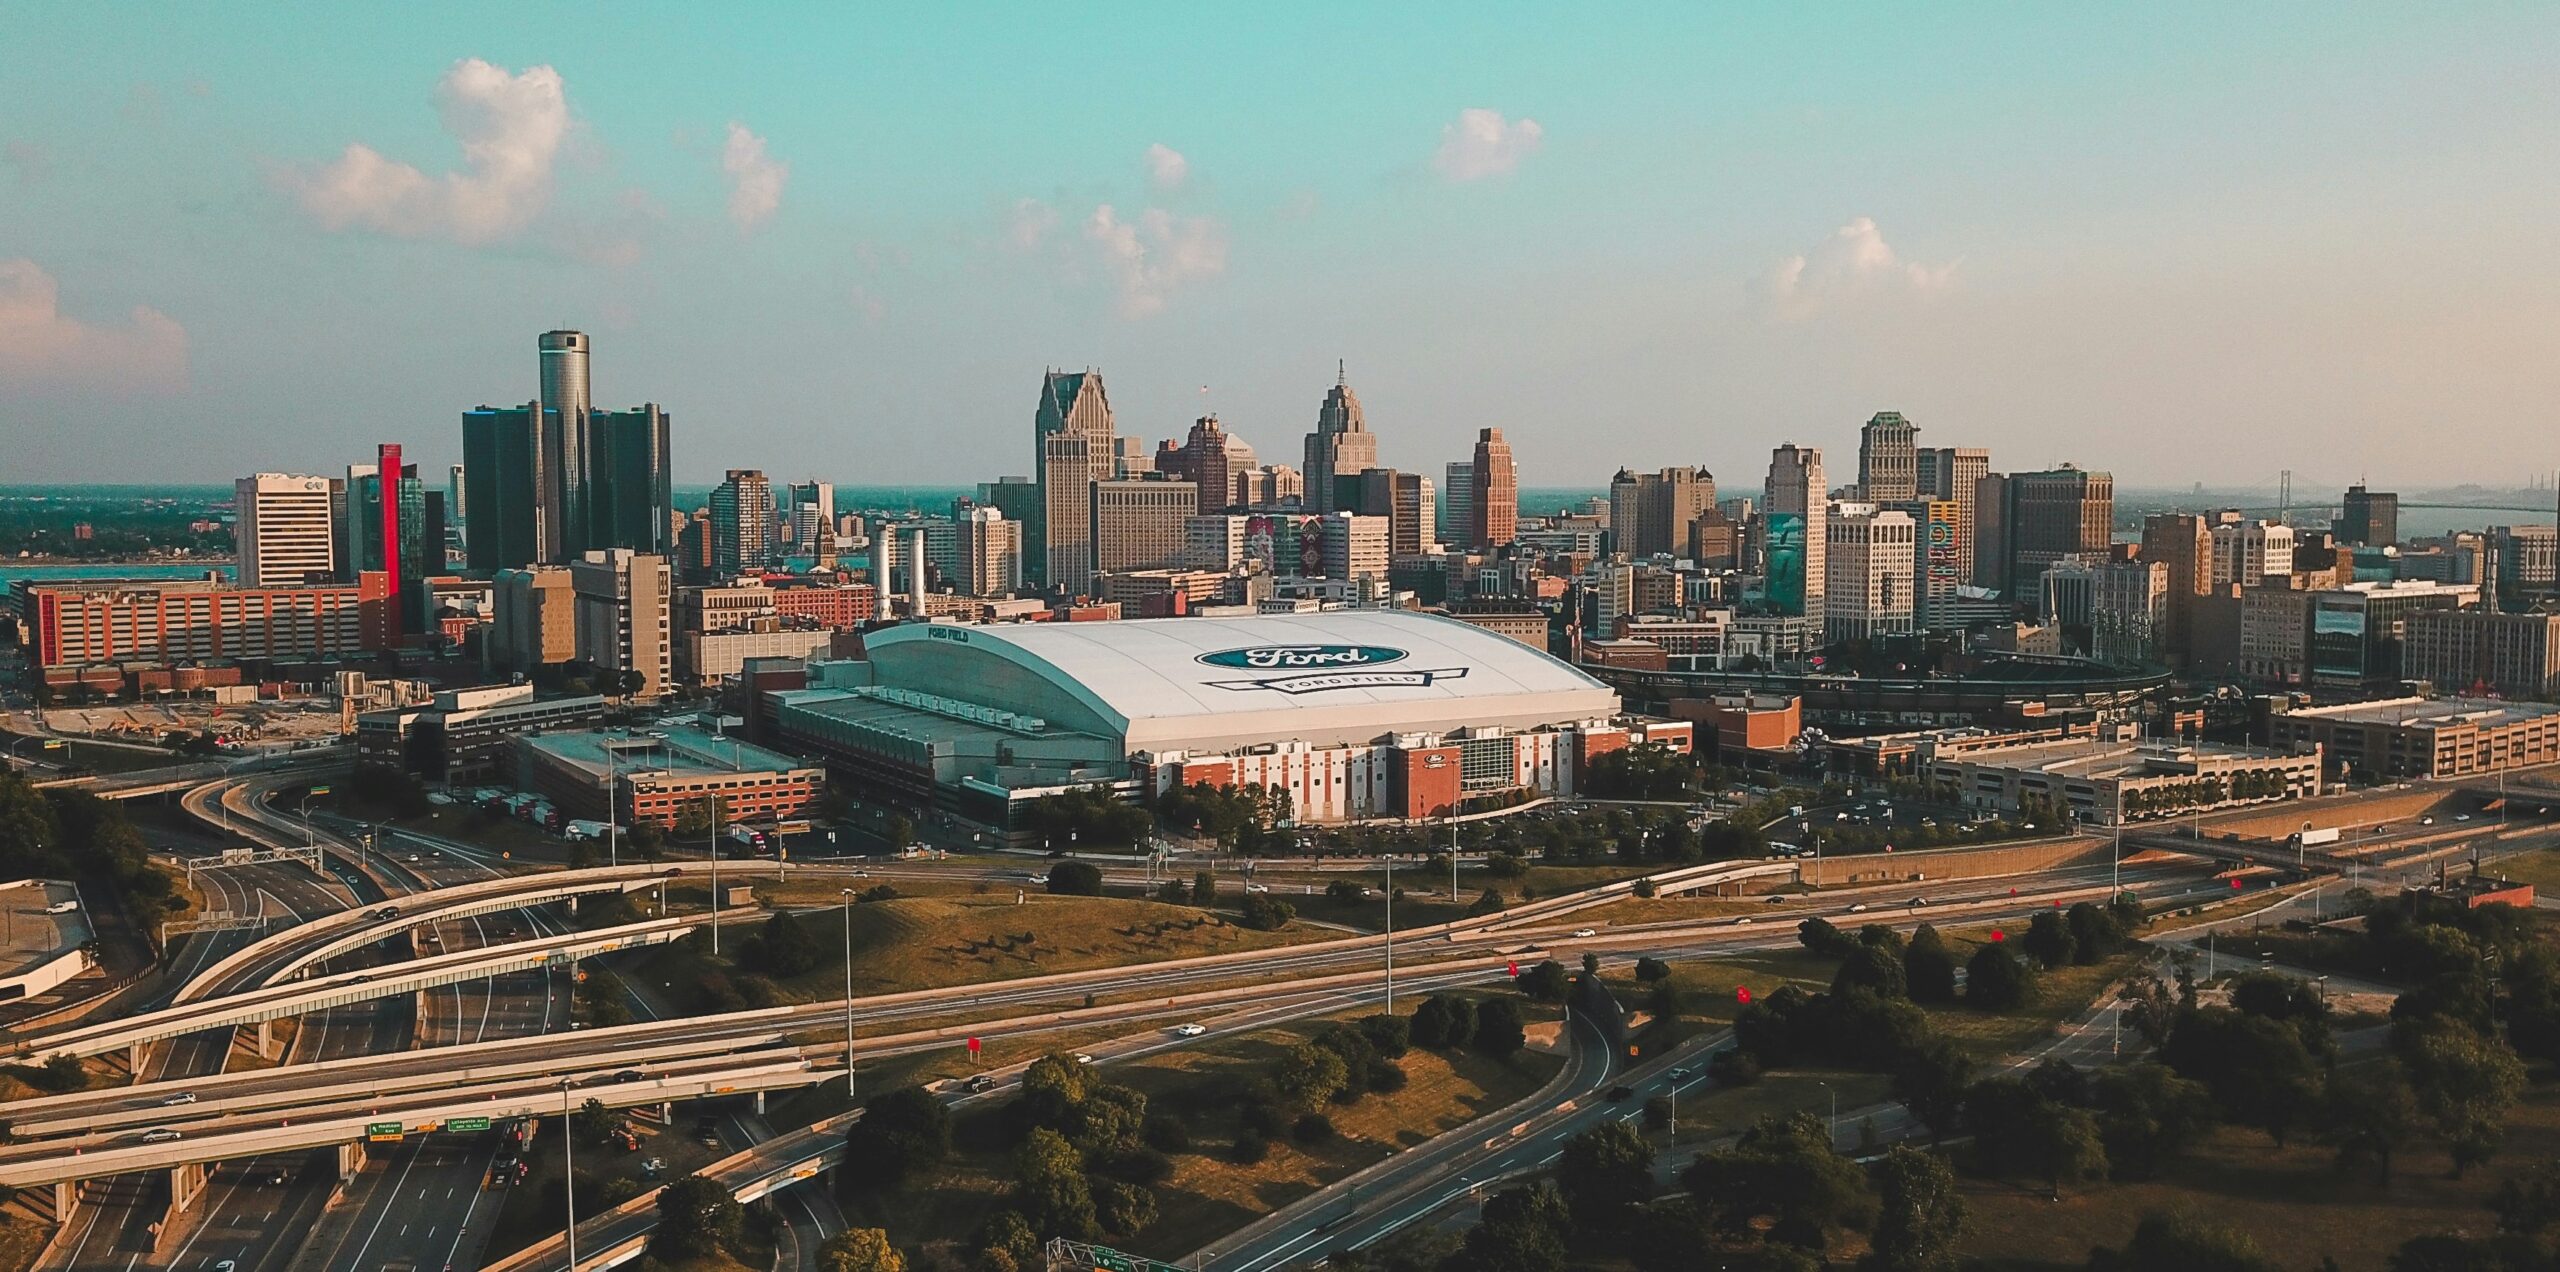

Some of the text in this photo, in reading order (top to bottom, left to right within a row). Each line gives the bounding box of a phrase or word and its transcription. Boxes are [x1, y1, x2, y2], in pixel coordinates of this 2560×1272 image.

[928, 627, 969, 643] FORD FIELD
[1245, 647, 1370, 667] Ford
[1284, 679, 1342, 689] FORD
